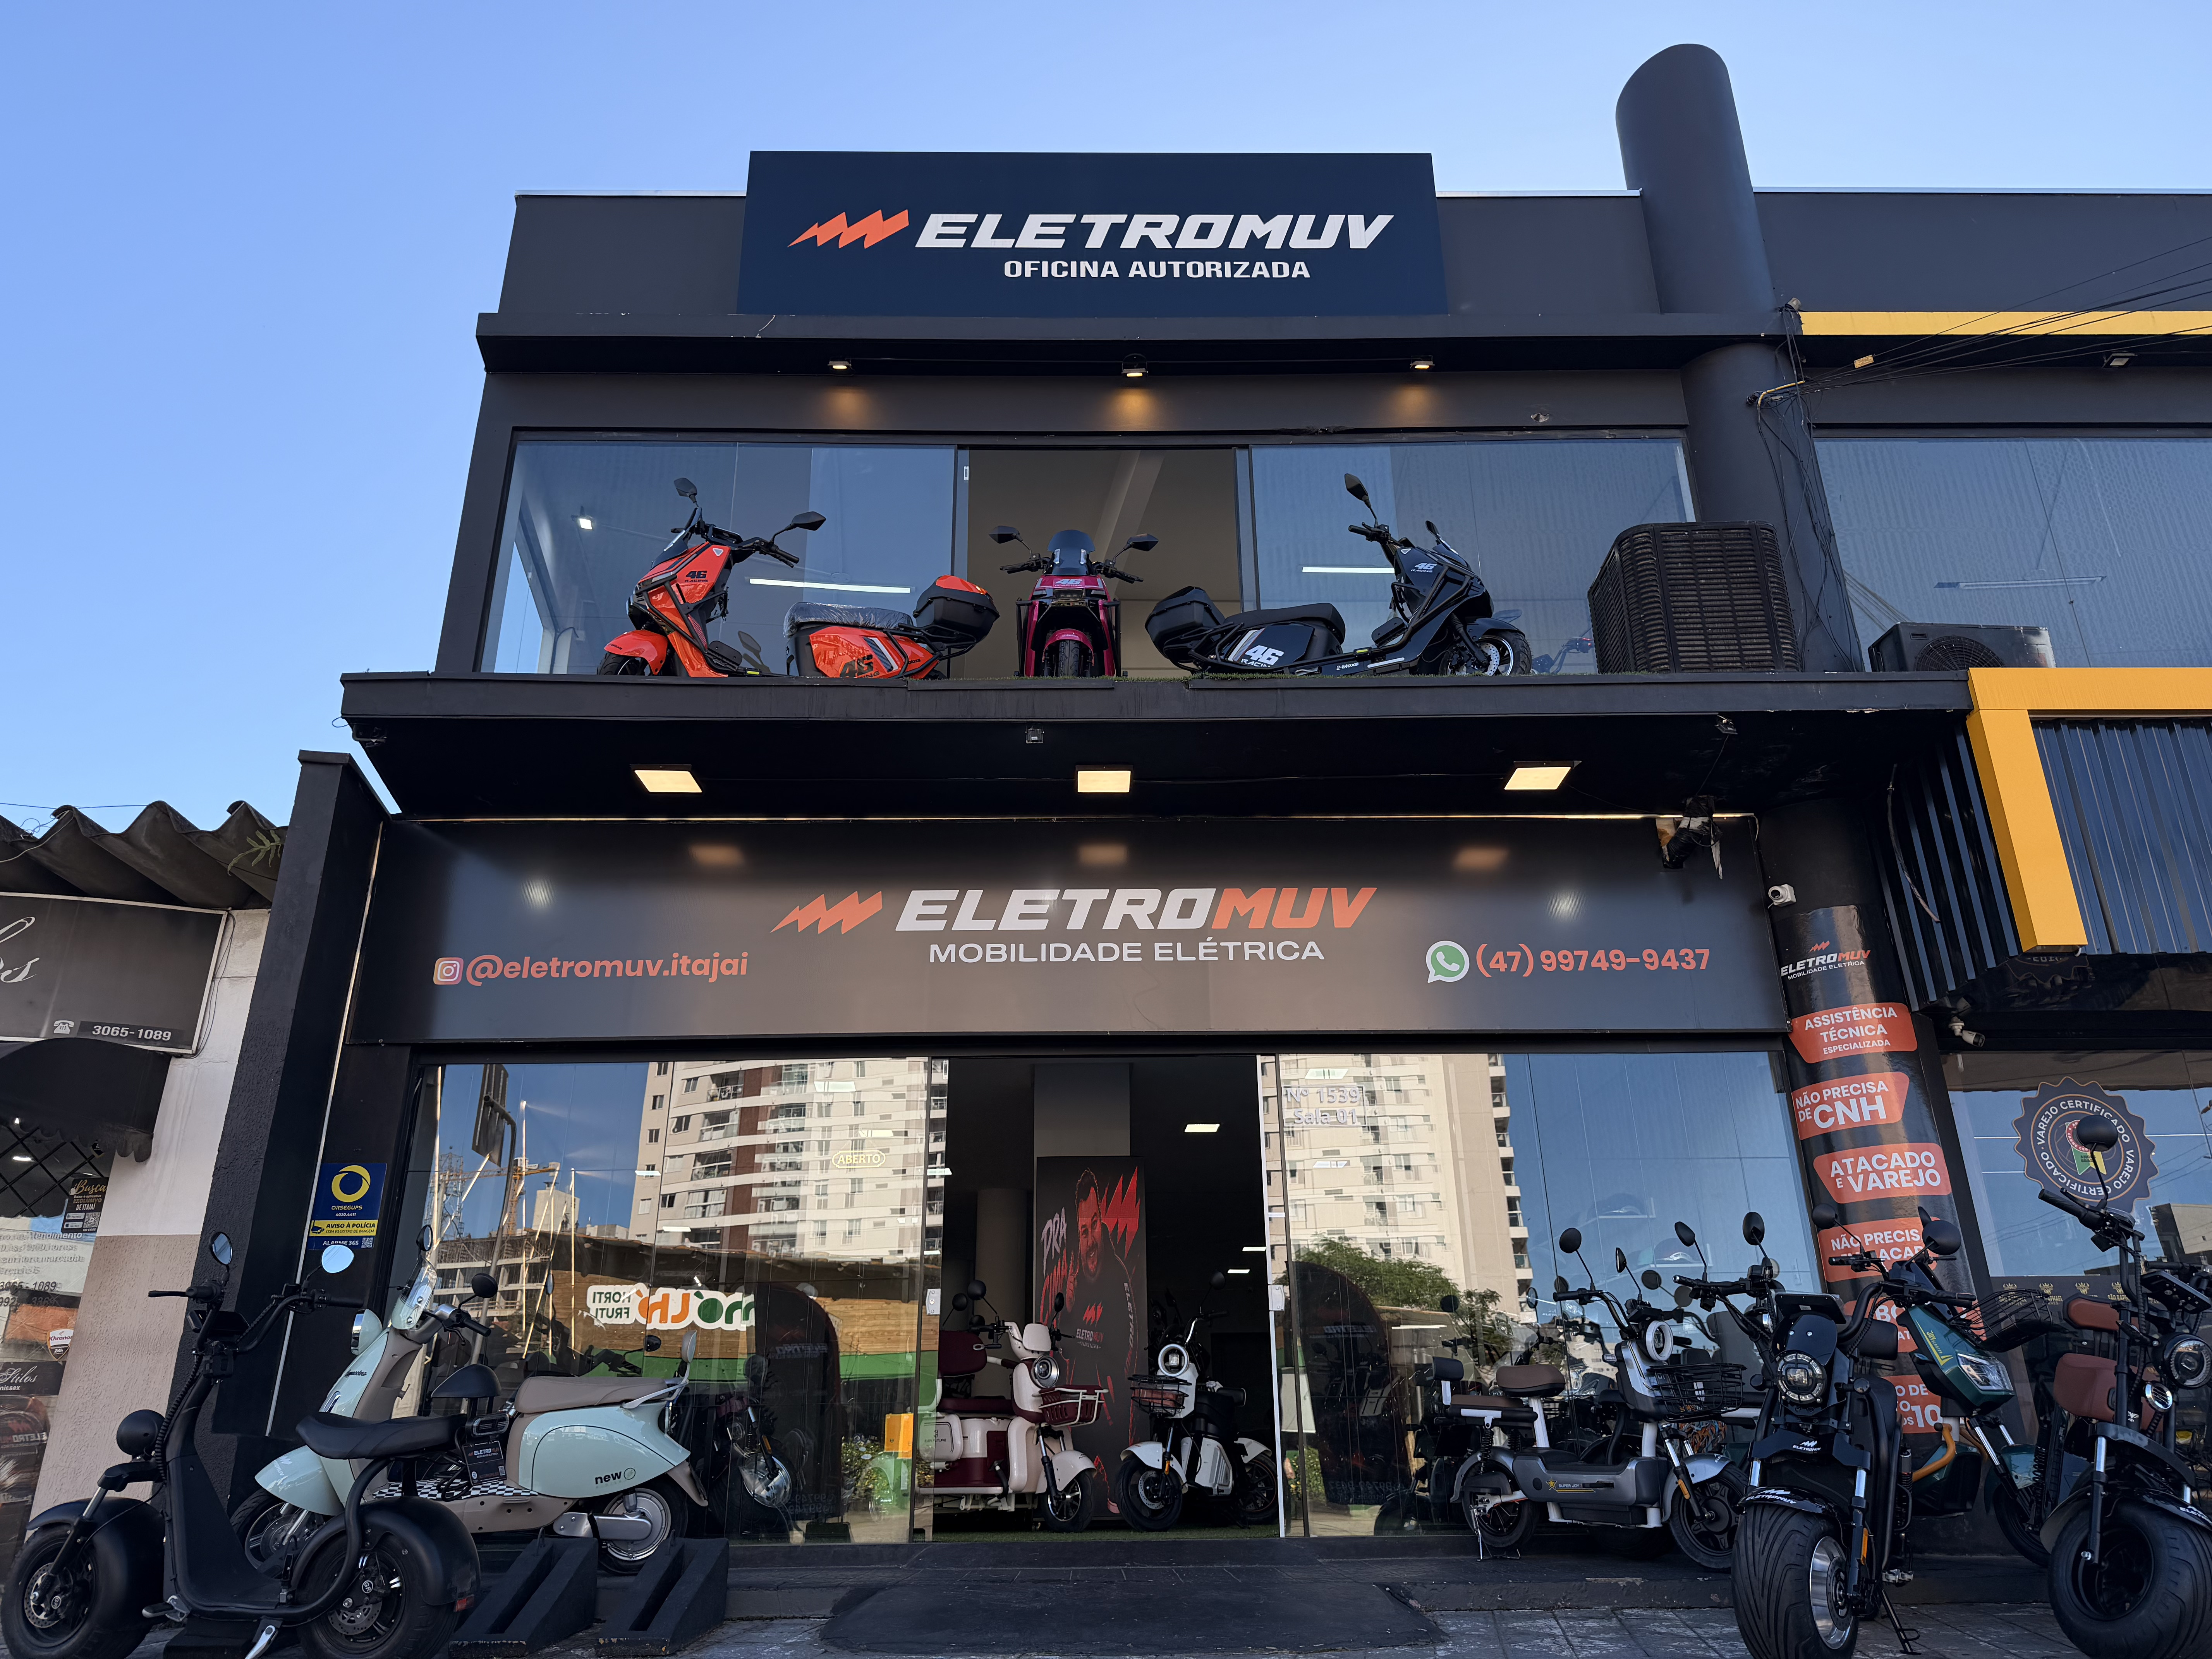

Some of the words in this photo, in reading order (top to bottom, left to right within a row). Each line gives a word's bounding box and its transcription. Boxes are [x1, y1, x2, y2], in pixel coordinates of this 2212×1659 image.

[915, 214, 1394, 249] ELETROMUV
[1004, 260, 1119, 279] OFICINA
[1128, 260, 1310, 279] AUTORIZADA
[840, 654, 873, 677] 46
[1245, 645, 1284, 665] 46
[895, 888, 1377, 931] ELETROMUV
[930, 943, 1142, 963] MOBILIDADE
[1154, 938, 1325, 961] ELÉTRICA
[1476, 943, 1534, 977] (47)
[1540, 949, 1710, 972] 99749-9437
[466, 952, 749, 986] @eletromuv.itajai
[1781, 950, 1870, 976] ELETROMUV
[1788, 966, 1827, 980] MOBILIDADE
[1805, 1007, 1898, 1030] ASSISTÊNCIA
[92, 1025, 171, 1041] 3065-1089
[1820, 1024, 1888, 1042] TÉCNICA
[1823, 1039, 1891, 1054] ESPECIALIZADA
[1317, 1087, 1360, 1103] 1539
[1795, 1092, 1820, 1109] NÃO
[1822, 1081, 1889, 1101] PRECISA
[1294, 1108, 1331, 1124] Sala
[1336, 1108, 1357, 1124] 01
[1798, 1108, 1812, 1122] DE
[1814, 1095, 1887, 1128] CNH
[2037, 1106, 2058, 1145] VAREJO
[2060, 1100, 2130, 1143] CERTIFICADO
[837, 1154, 881, 1165] ABERTO
[1831, 1151, 1935, 1178] ATACADO
[2113, 1149, 2134, 1189] VAREJO
[1836, 1178, 1843, 1188] E
[1847, 1169, 1941, 1193] VAREJO
[1041, 1207, 1067, 1278] PRA
[1831, 1233, 1860, 1251] NÃO
[1863, 1229, 1920, 1246] PRECIS
[33, 1281, 57, 1291] 1089
[595, 1471, 622, 1485] new
[1745, 1494, 1797, 1504] ELETROMUV
